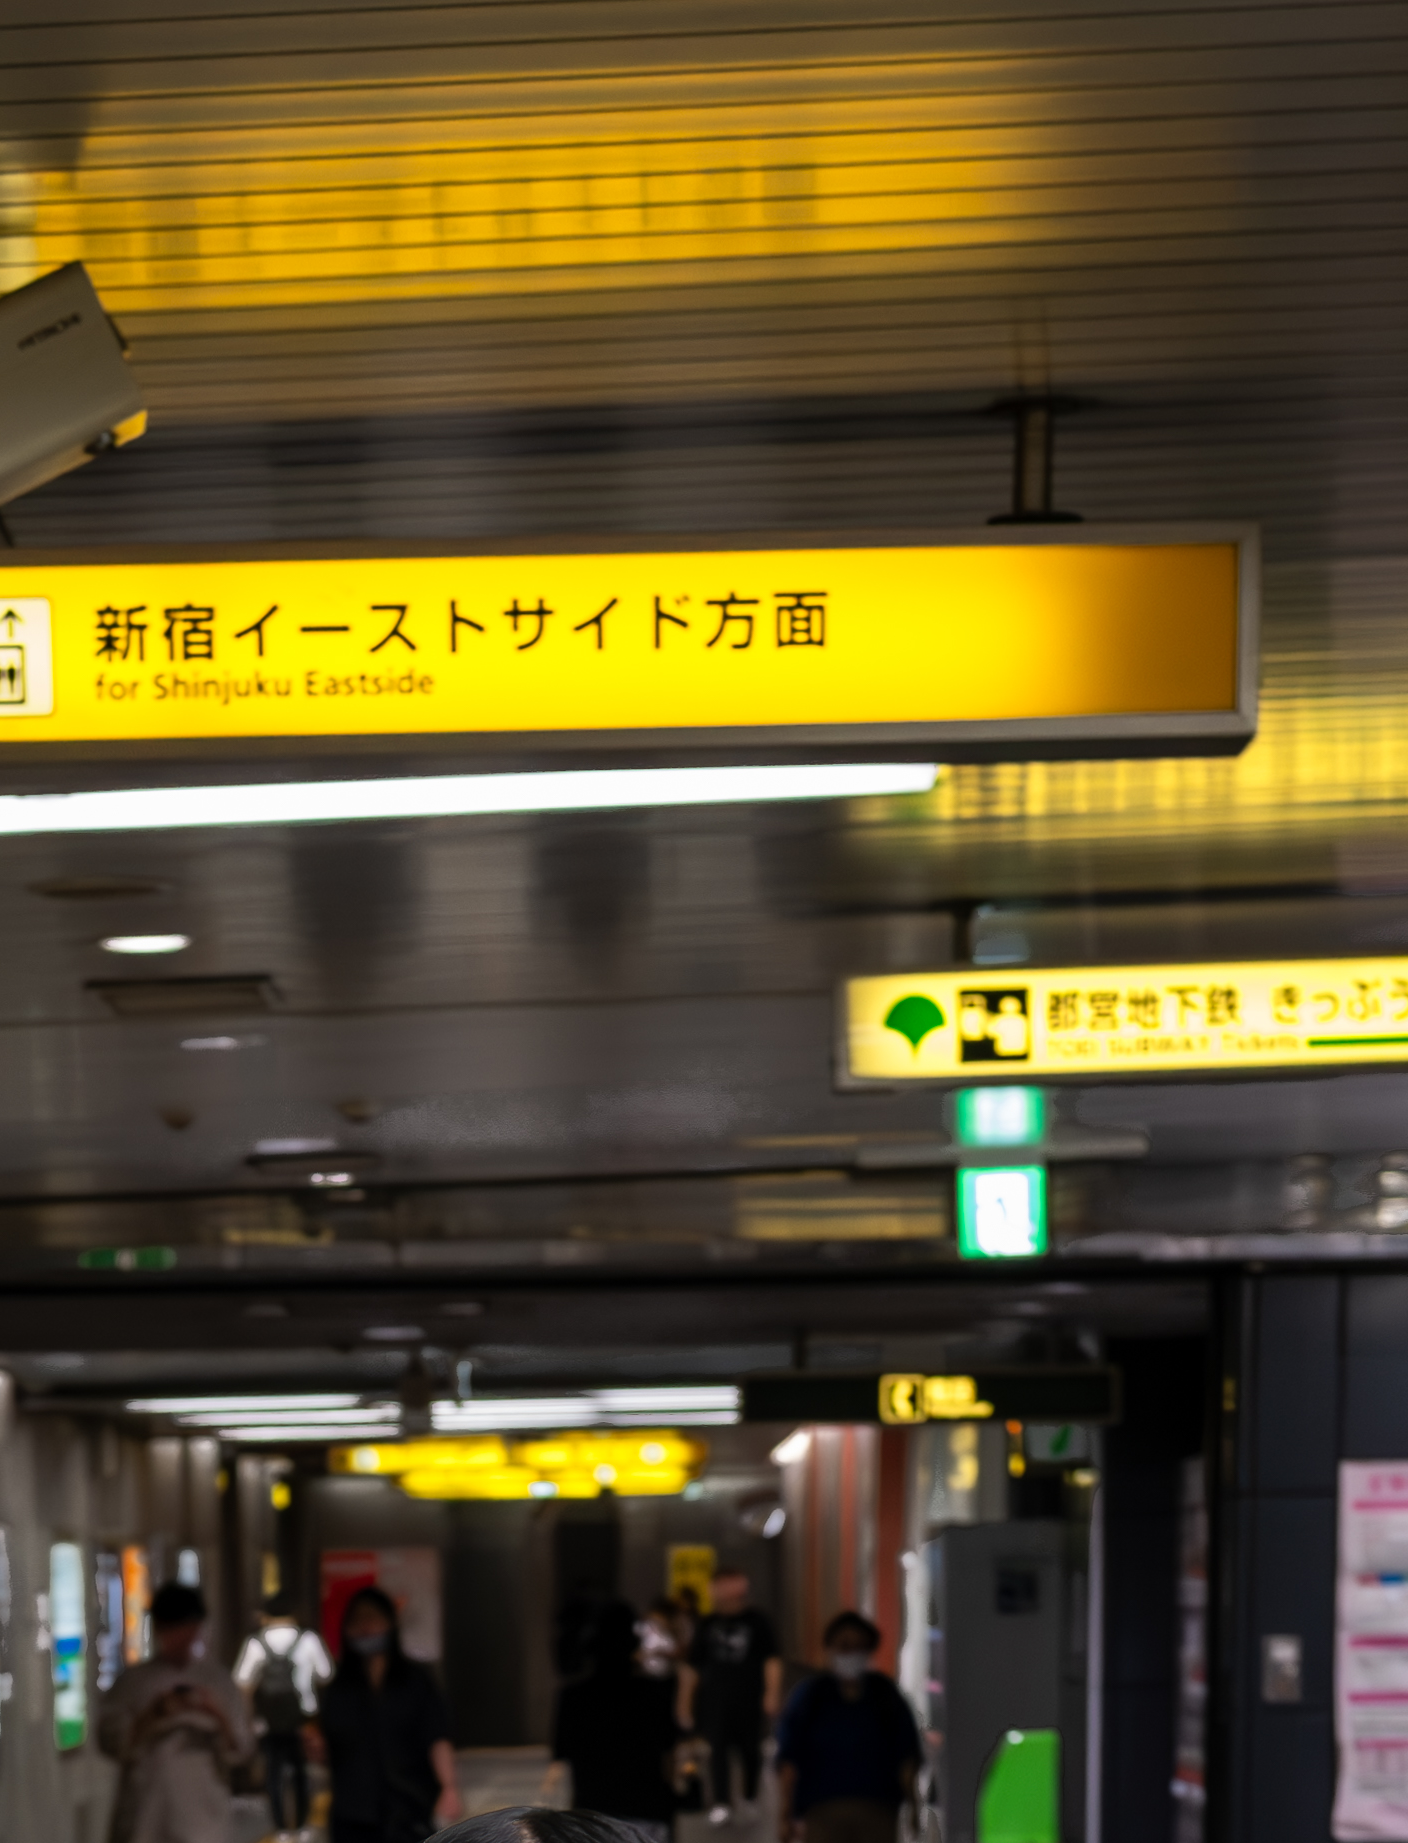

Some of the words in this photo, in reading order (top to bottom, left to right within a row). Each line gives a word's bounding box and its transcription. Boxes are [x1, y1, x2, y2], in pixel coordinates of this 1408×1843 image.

[95, 591, 829, 663] 新宿イーストサイド方面
[96, 673, 140, 702] for
[153, 671, 292, 706] Shinjuku
[305, 668, 435, 699] Eastside
